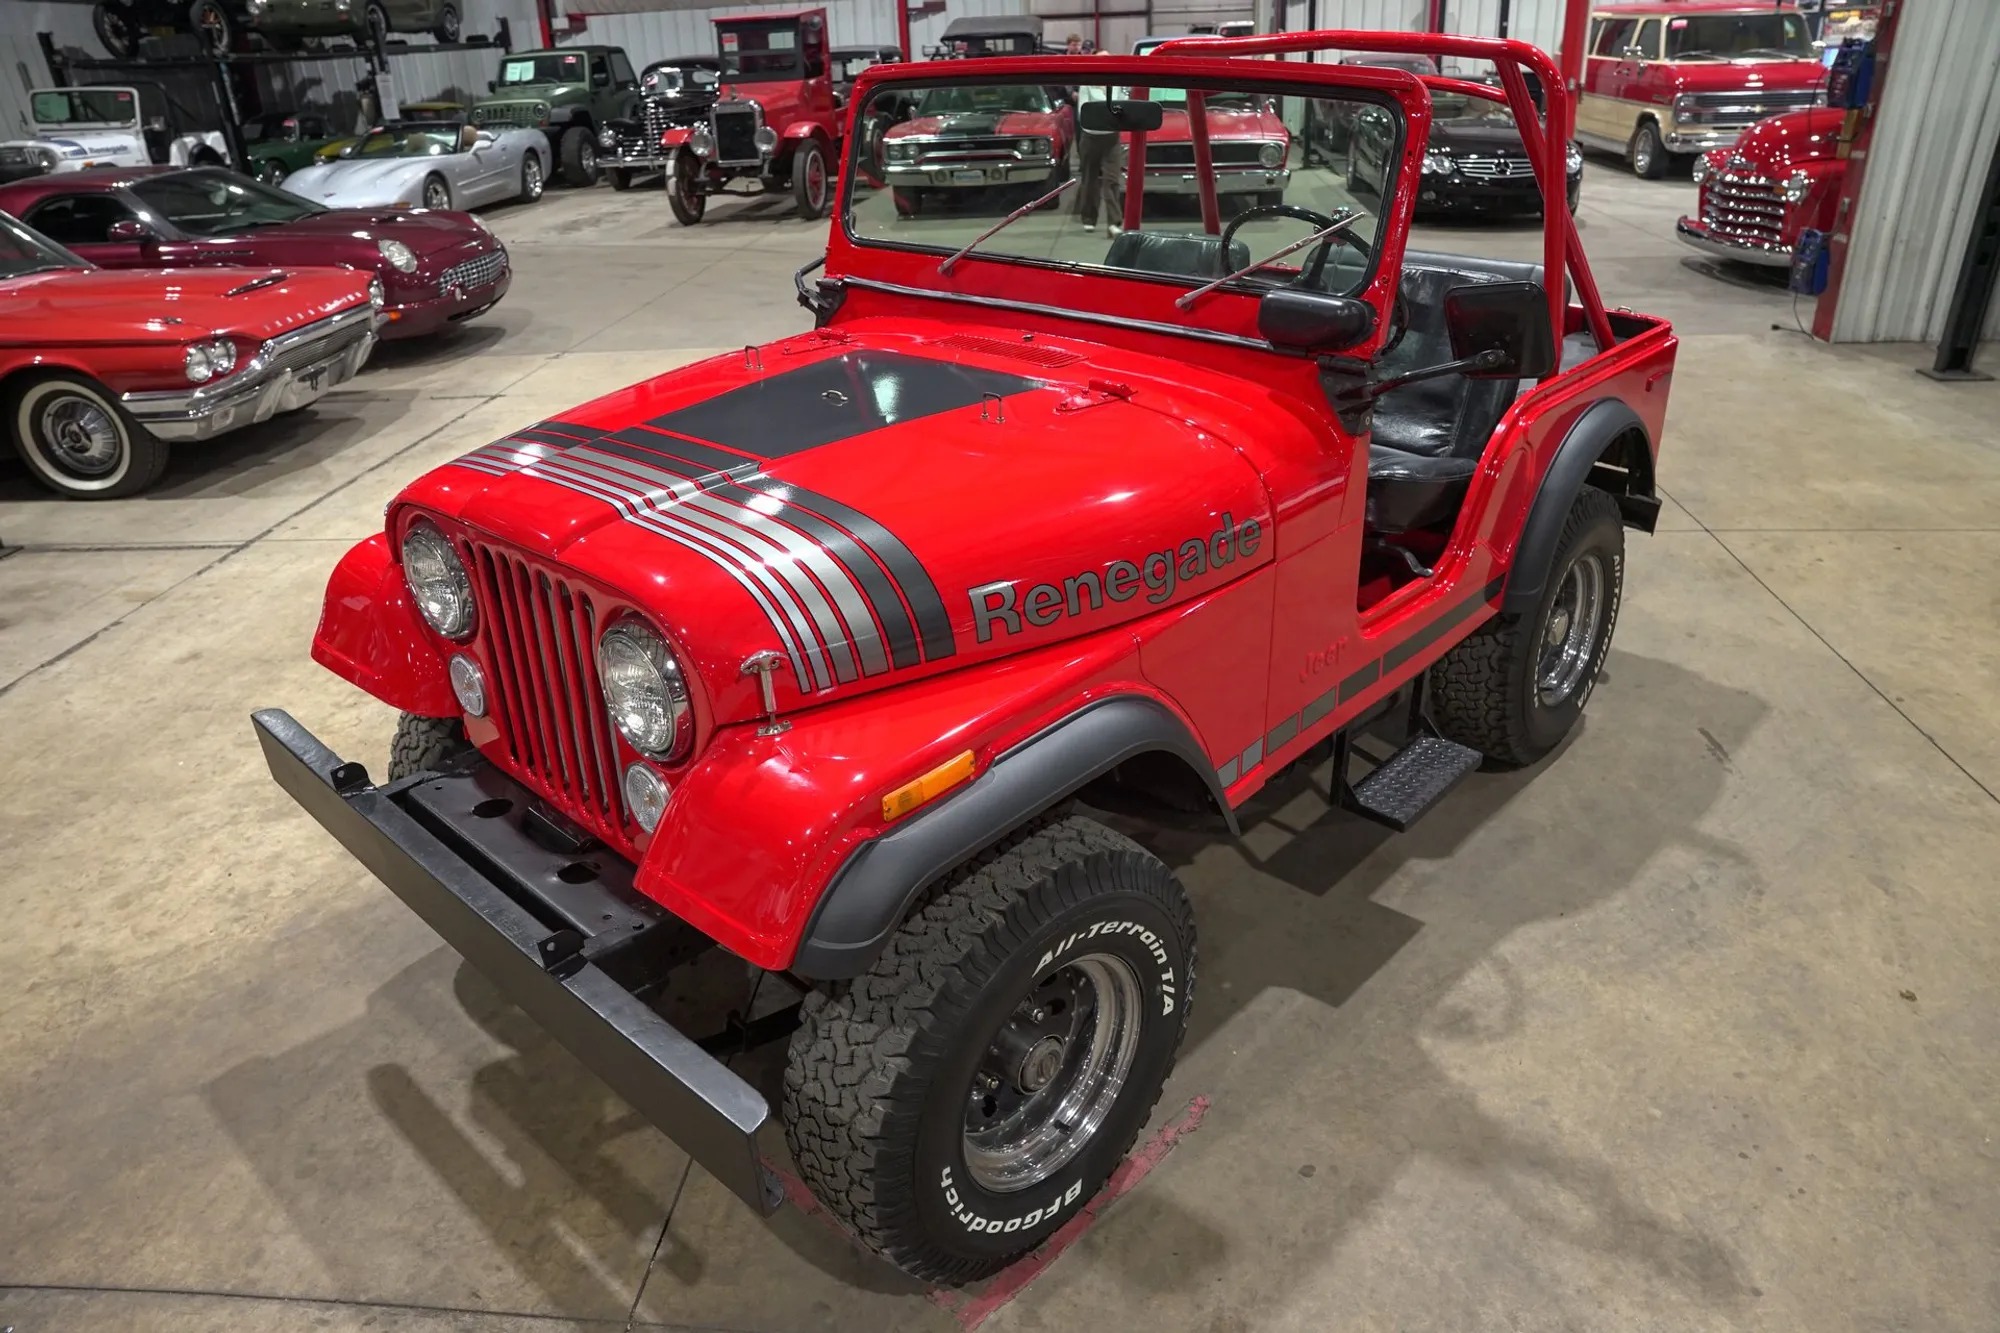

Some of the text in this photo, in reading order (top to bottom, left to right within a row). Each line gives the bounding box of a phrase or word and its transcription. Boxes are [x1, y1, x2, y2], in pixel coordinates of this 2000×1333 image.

[967, 511, 1262, 643] Renegade
[1298, 636, 1349, 684] Jeep
[1031, 920, 1176, 1016] All-Terrain T/A
[940, 1165, 1083, 1234] BFGoodrich
